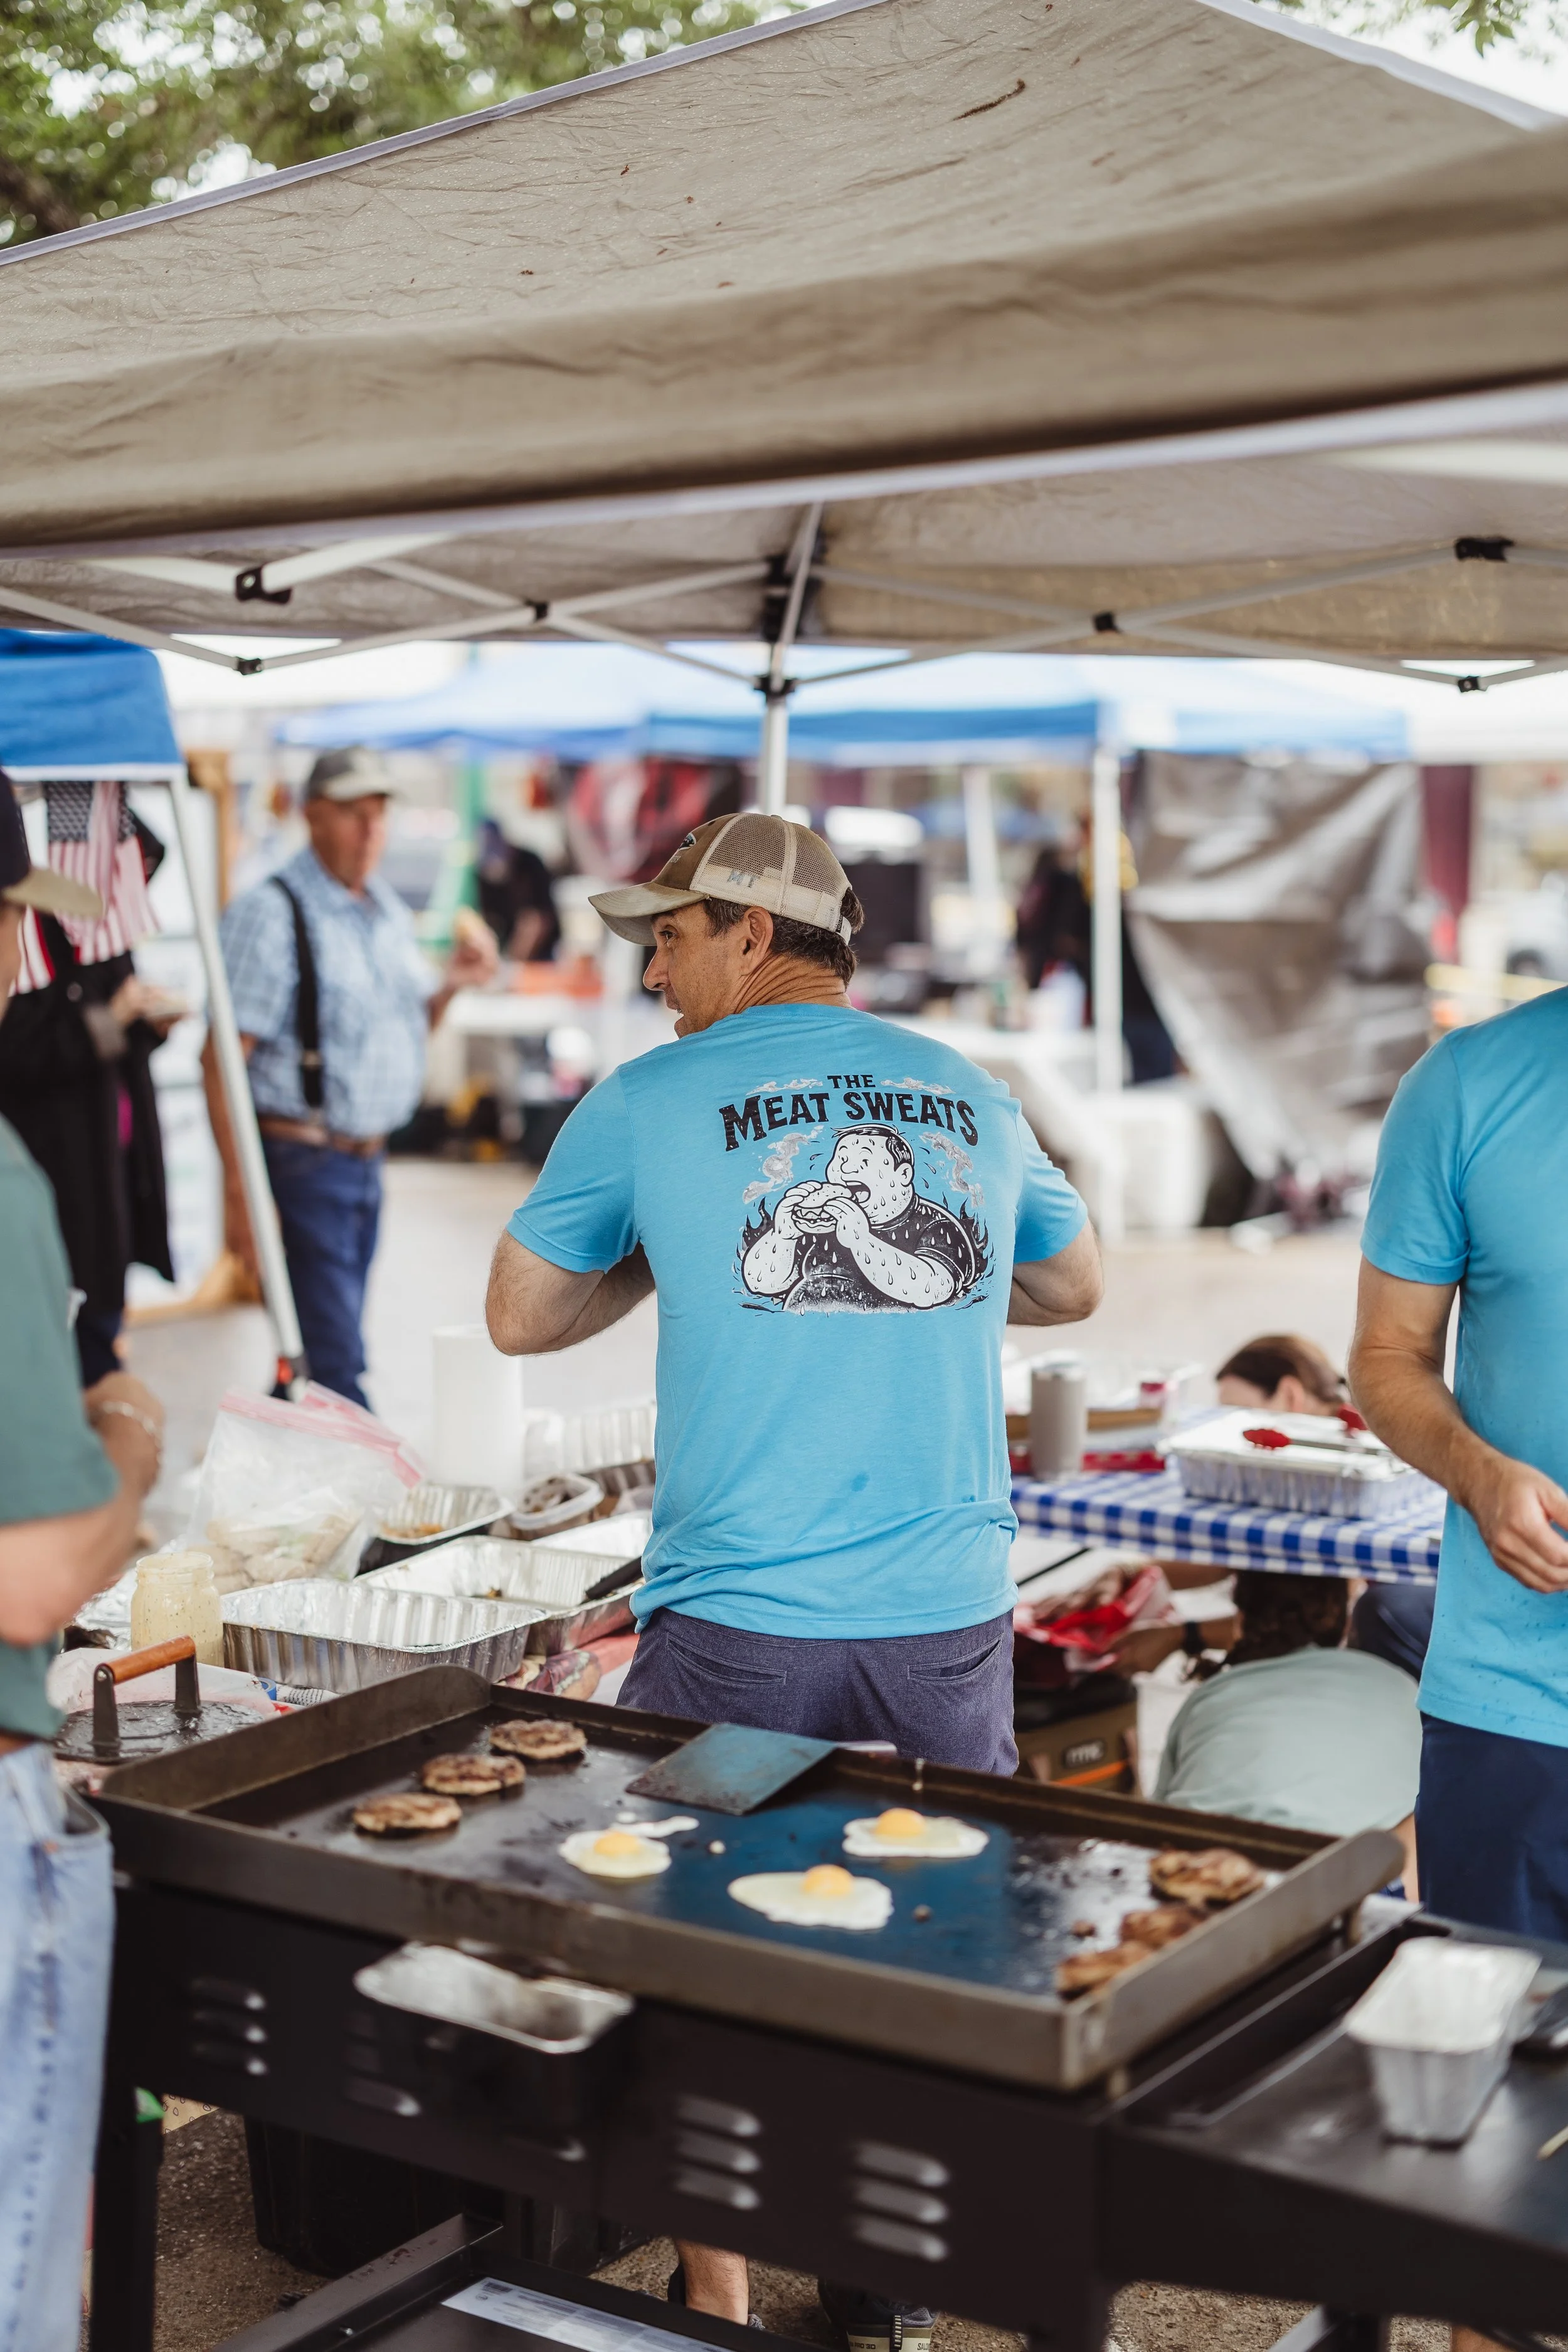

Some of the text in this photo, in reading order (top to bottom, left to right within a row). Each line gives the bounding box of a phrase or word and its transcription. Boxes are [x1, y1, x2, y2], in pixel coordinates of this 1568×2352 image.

[827, 1074, 876, 1089] THE
[718, 1091, 978, 1152] MEAT SWEATS
